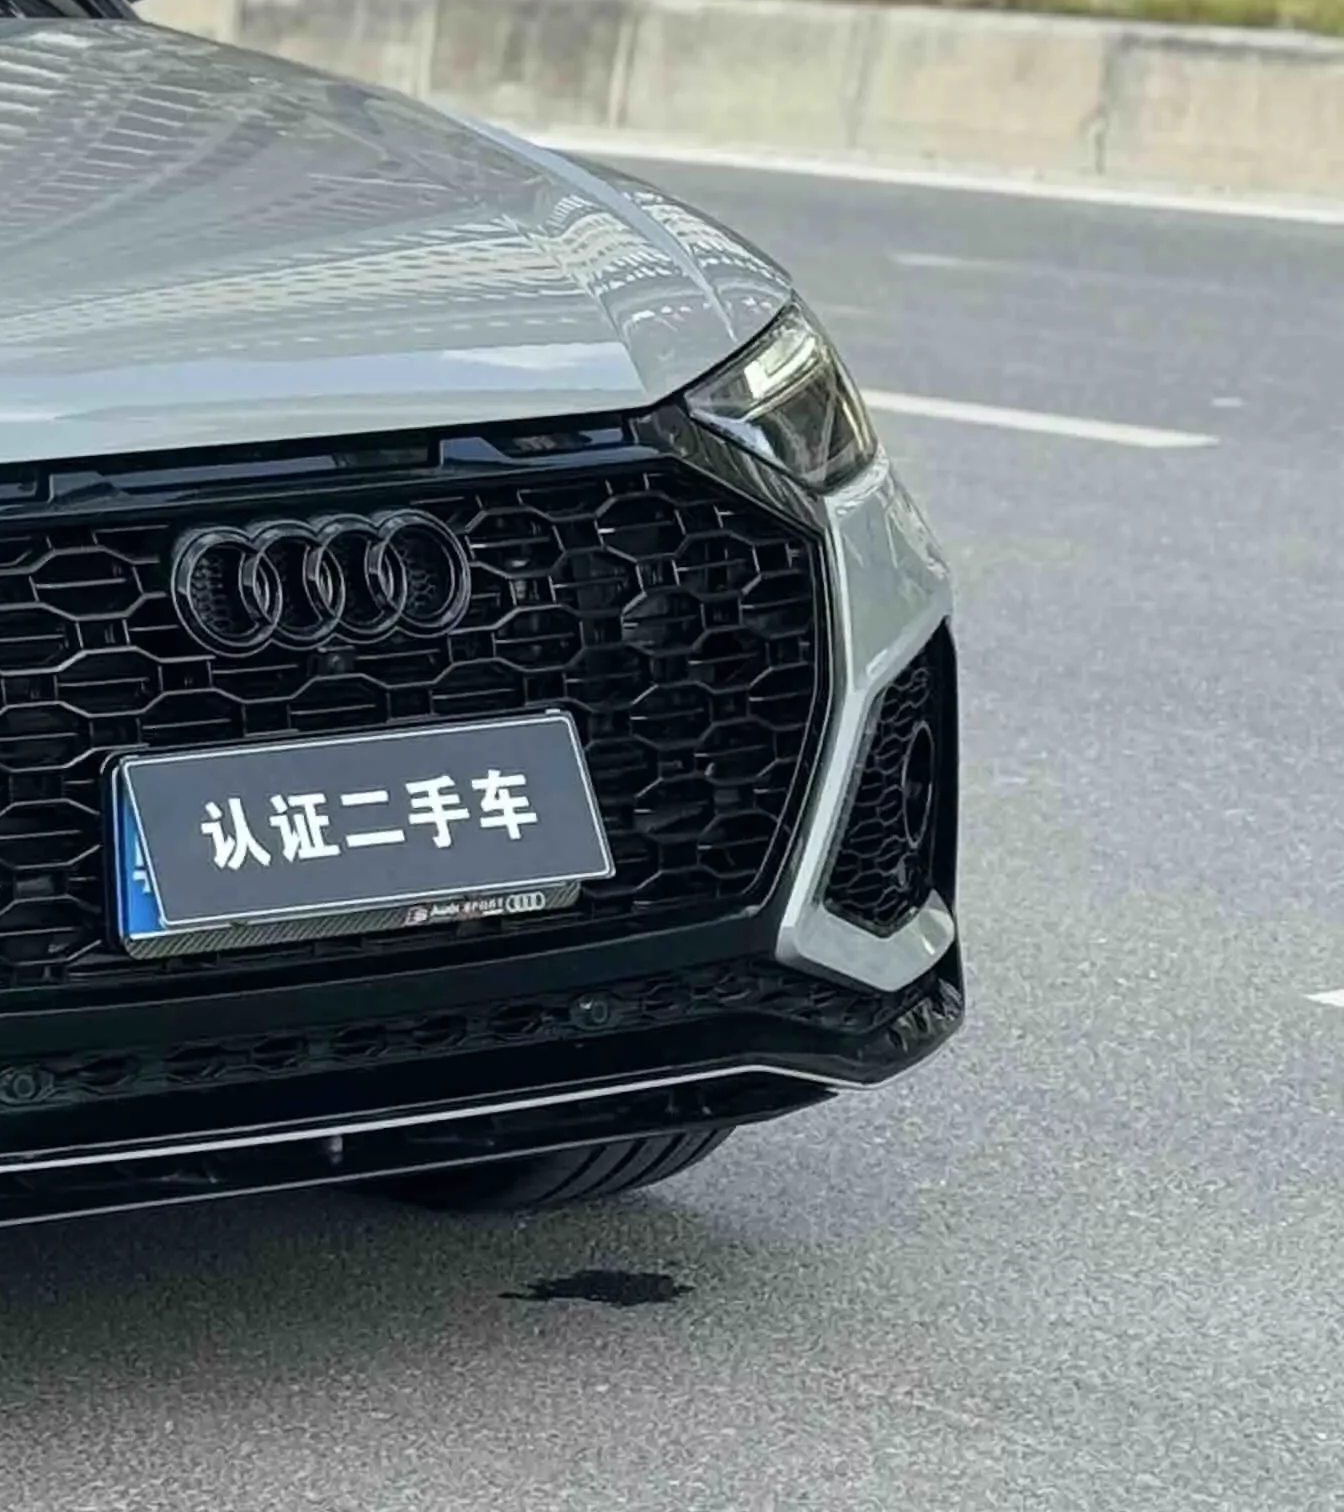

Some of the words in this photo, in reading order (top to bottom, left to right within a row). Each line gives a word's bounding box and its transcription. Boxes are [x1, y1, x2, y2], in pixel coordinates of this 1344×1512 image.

[201, 768, 538, 871] 认证二手车
